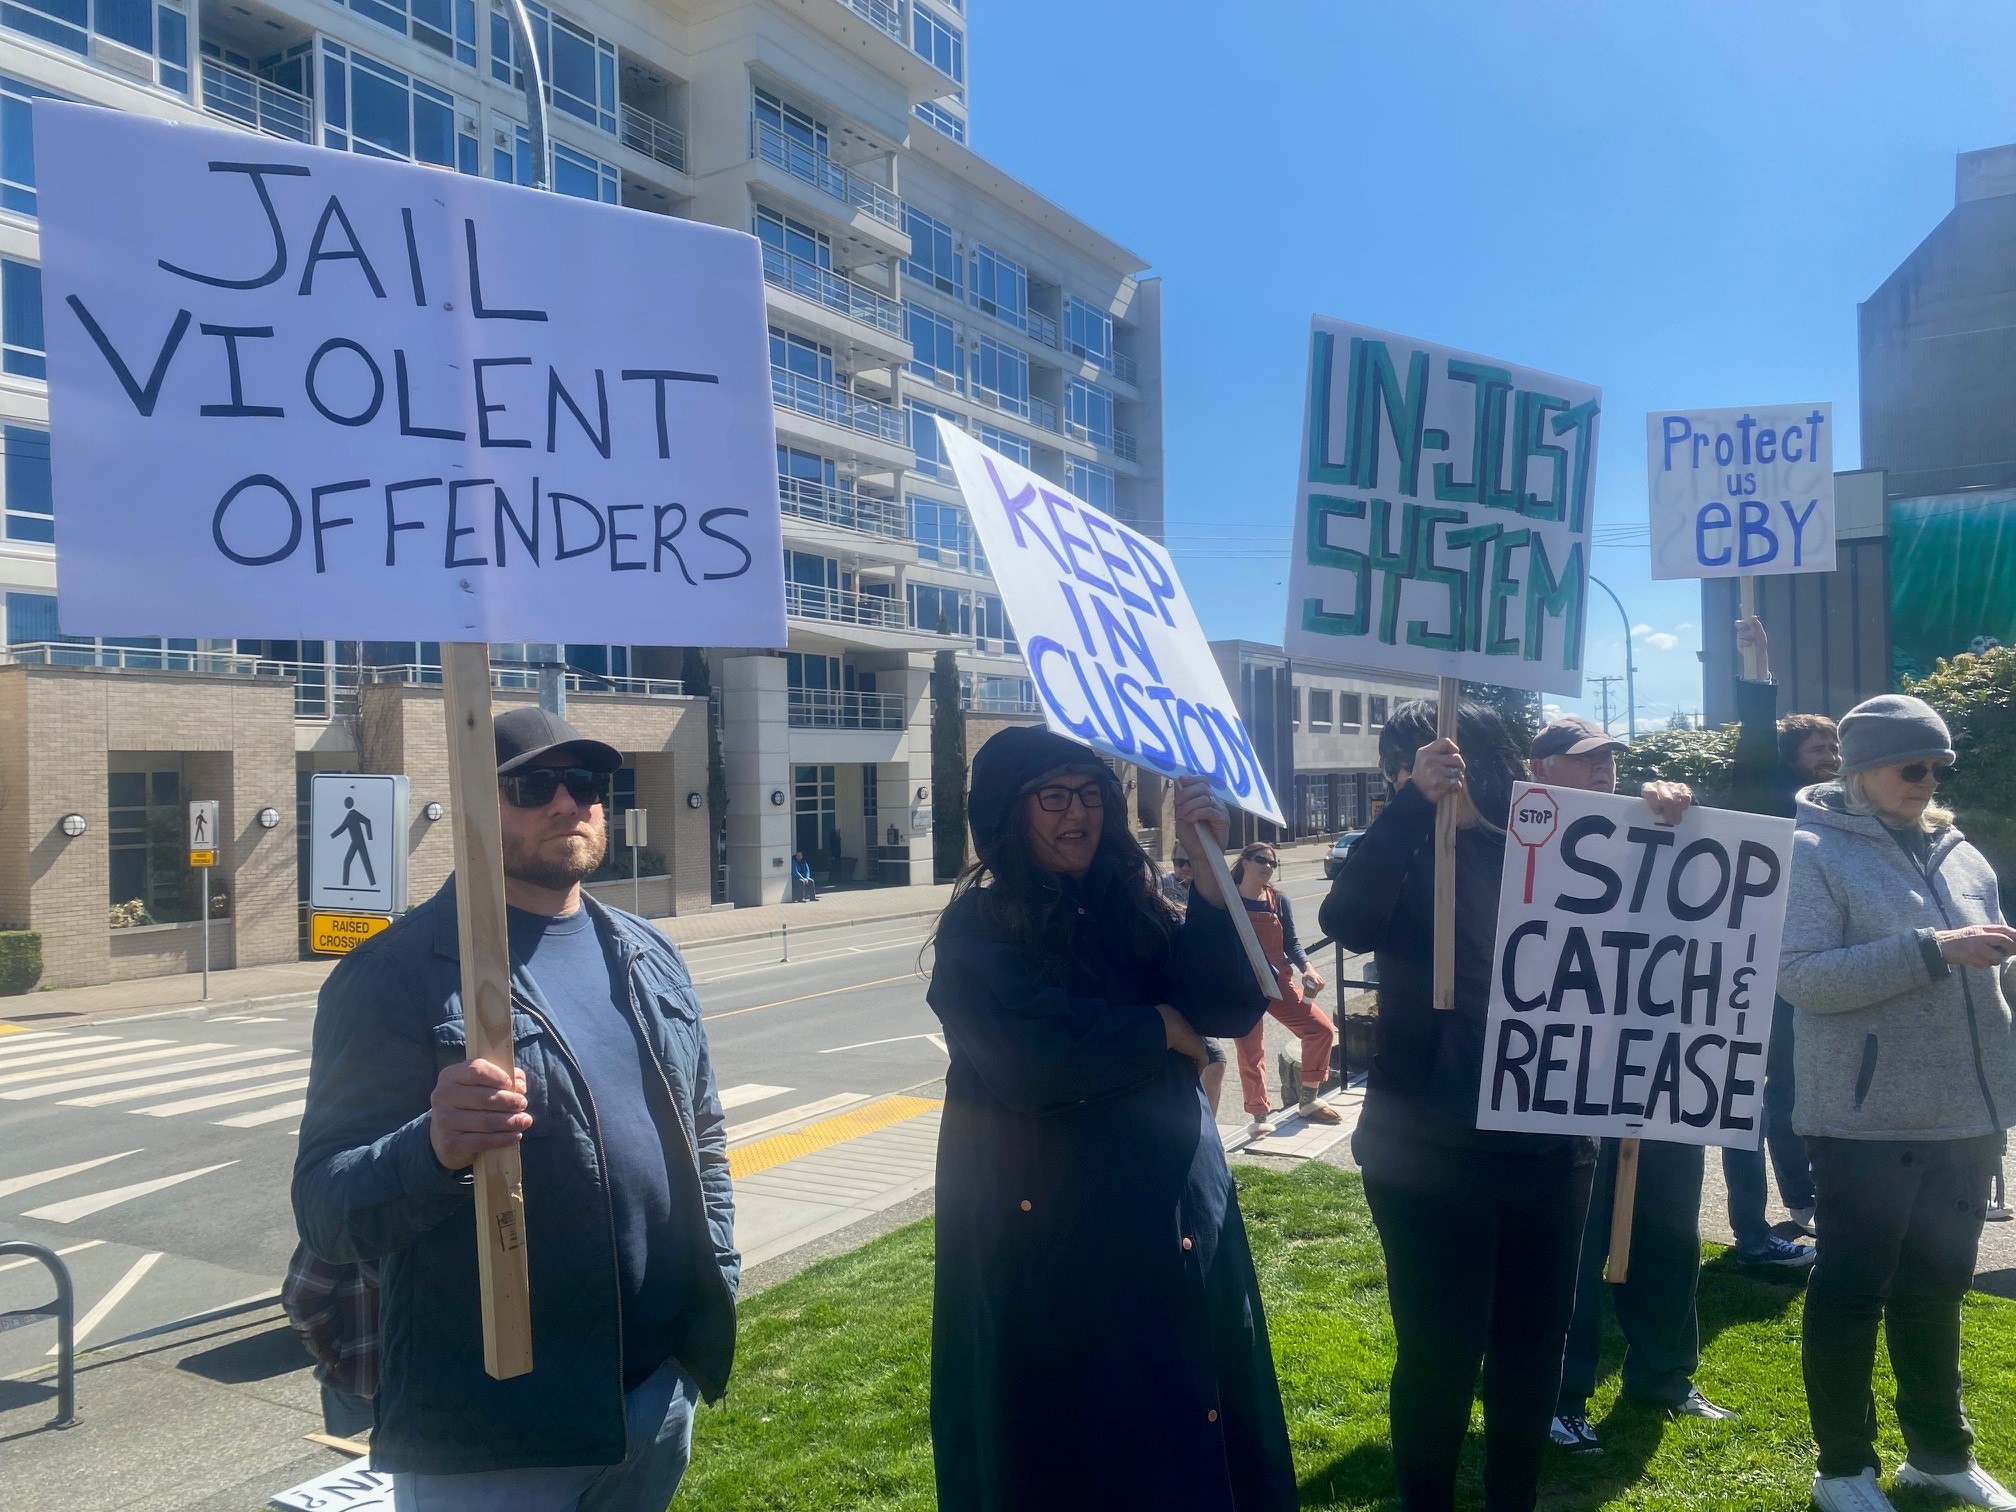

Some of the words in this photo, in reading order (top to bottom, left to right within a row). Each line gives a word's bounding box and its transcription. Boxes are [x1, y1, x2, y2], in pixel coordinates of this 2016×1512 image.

[157, 161, 549, 322] JAIL
[65, 294, 719, 460] VIOLENT
[1307, 331, 1600, 533] UN-JUST
[1663, 410, 1825, 472] Protect
[1726, 472, 1757, 497] us
[212, 474, 752, 586] OFFENDERS
[981, 454, 1177, 629] KEEP
[1301, 493, 1584, 671] SYSTEM
[1058, 580, 1164, 684] IN
[1027, 635, 1273, 813] CUSTODY
[1518, 808, 1553, 825] STOP
[1554, 814, 1781, 930] STOP
[332, 920, 370, 933] RAISED
[1501, 920, 1723, 1027] CATCH
[1490, 1018, 1763, 1131] RELEASE
